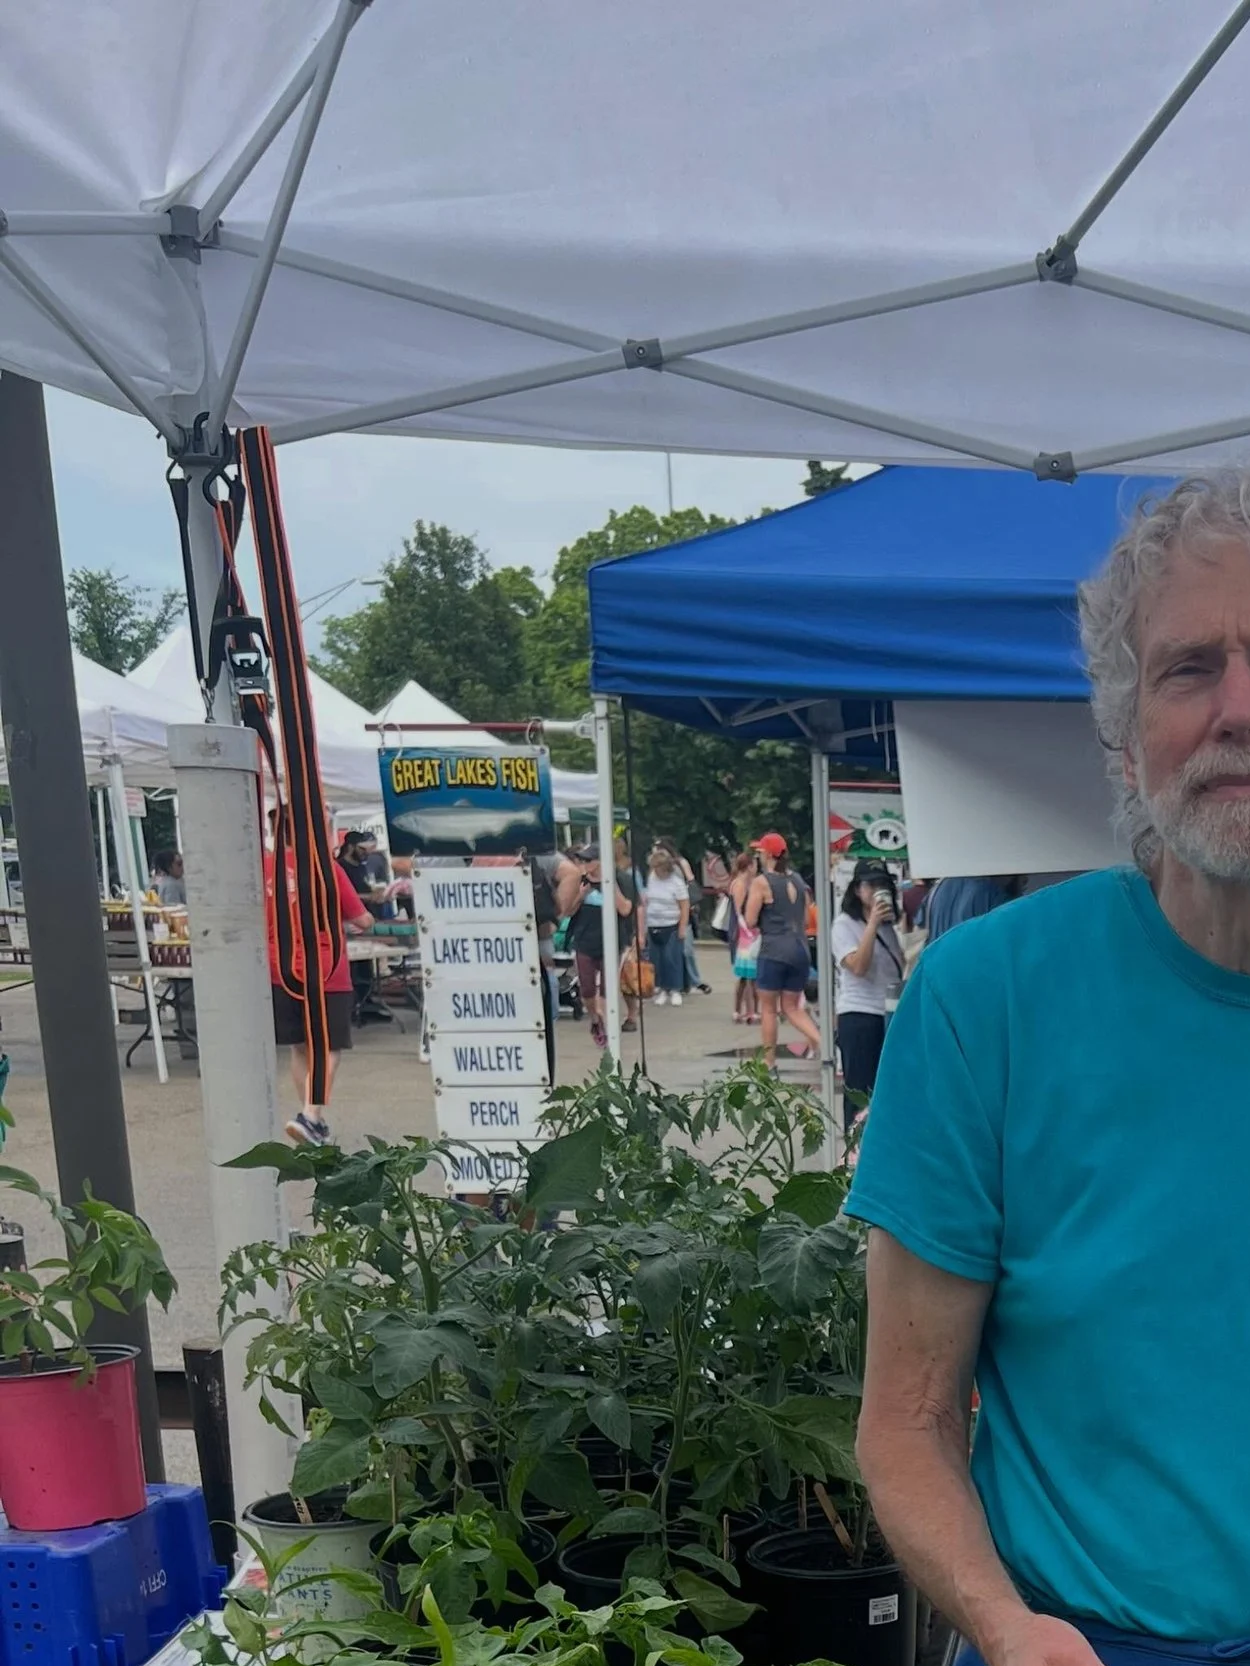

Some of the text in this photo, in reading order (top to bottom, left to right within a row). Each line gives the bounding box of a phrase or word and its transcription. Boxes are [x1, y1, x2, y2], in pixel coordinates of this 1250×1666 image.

[391, 757, 540, 793] GREAT LAKES FISH
[431, 881, 516, 909] WHITEFISH
[432, 937, 524, 964] LAKE TROUT
[452, 992, 517, 1019] SALMON
[453, 1046, 524, 1072] WALLEYE
[470, 1101, 519, 1126] PERCH
